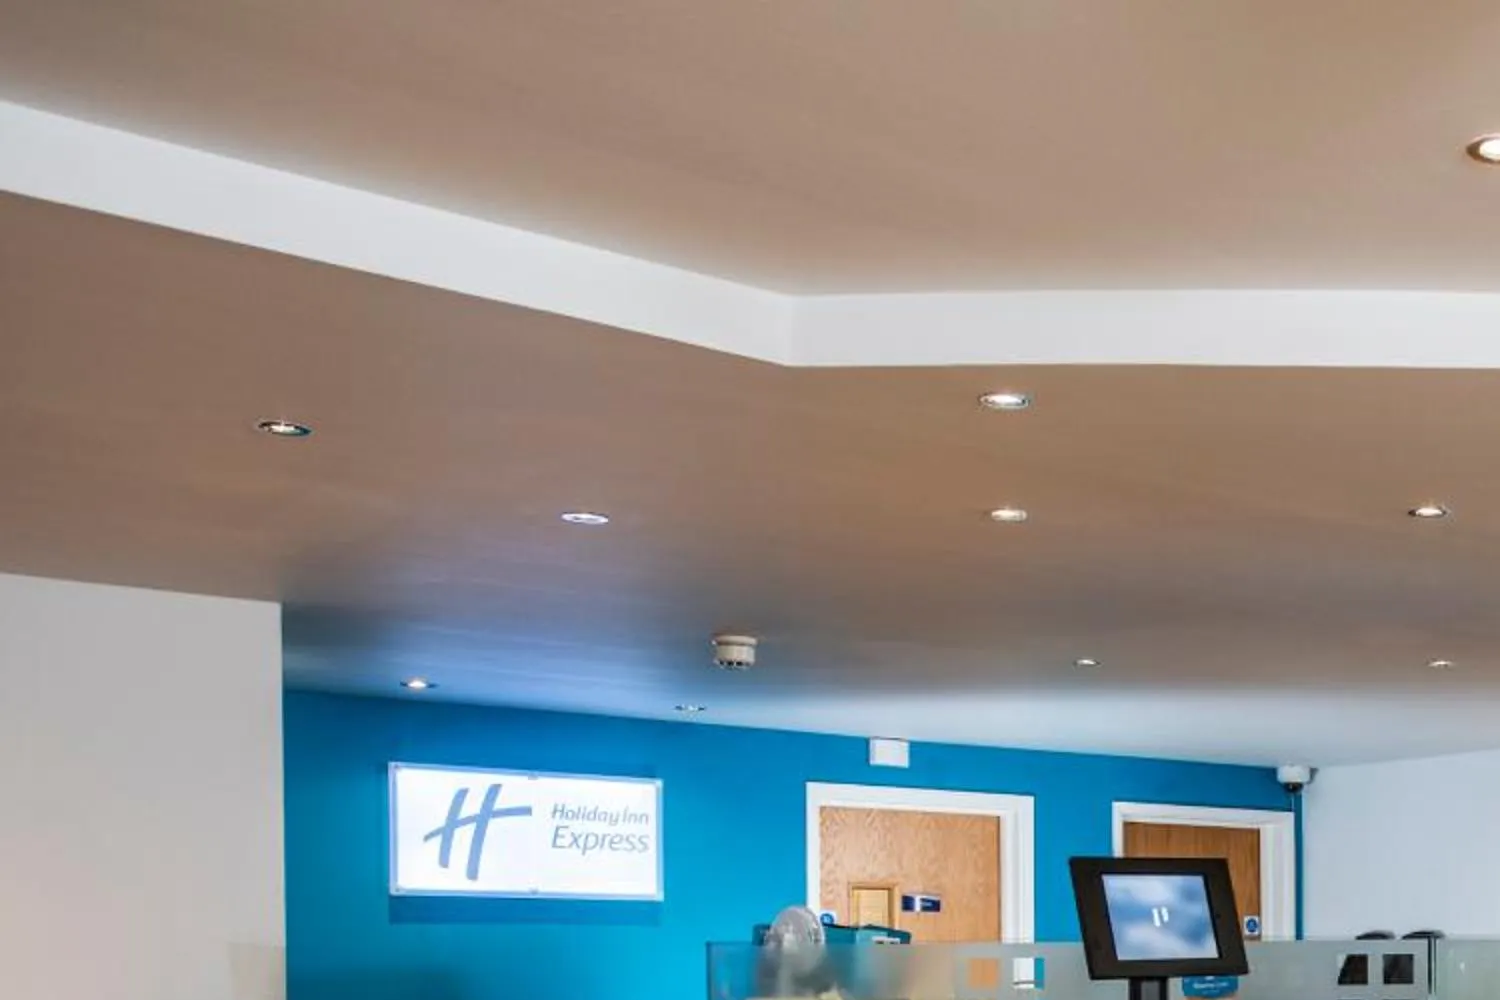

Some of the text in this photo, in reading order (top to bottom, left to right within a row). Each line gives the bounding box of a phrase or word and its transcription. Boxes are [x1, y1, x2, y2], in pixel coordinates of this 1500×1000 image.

[551, 803, 649, 826] Holiday Inn
[551, 825, 650, 856] Express
